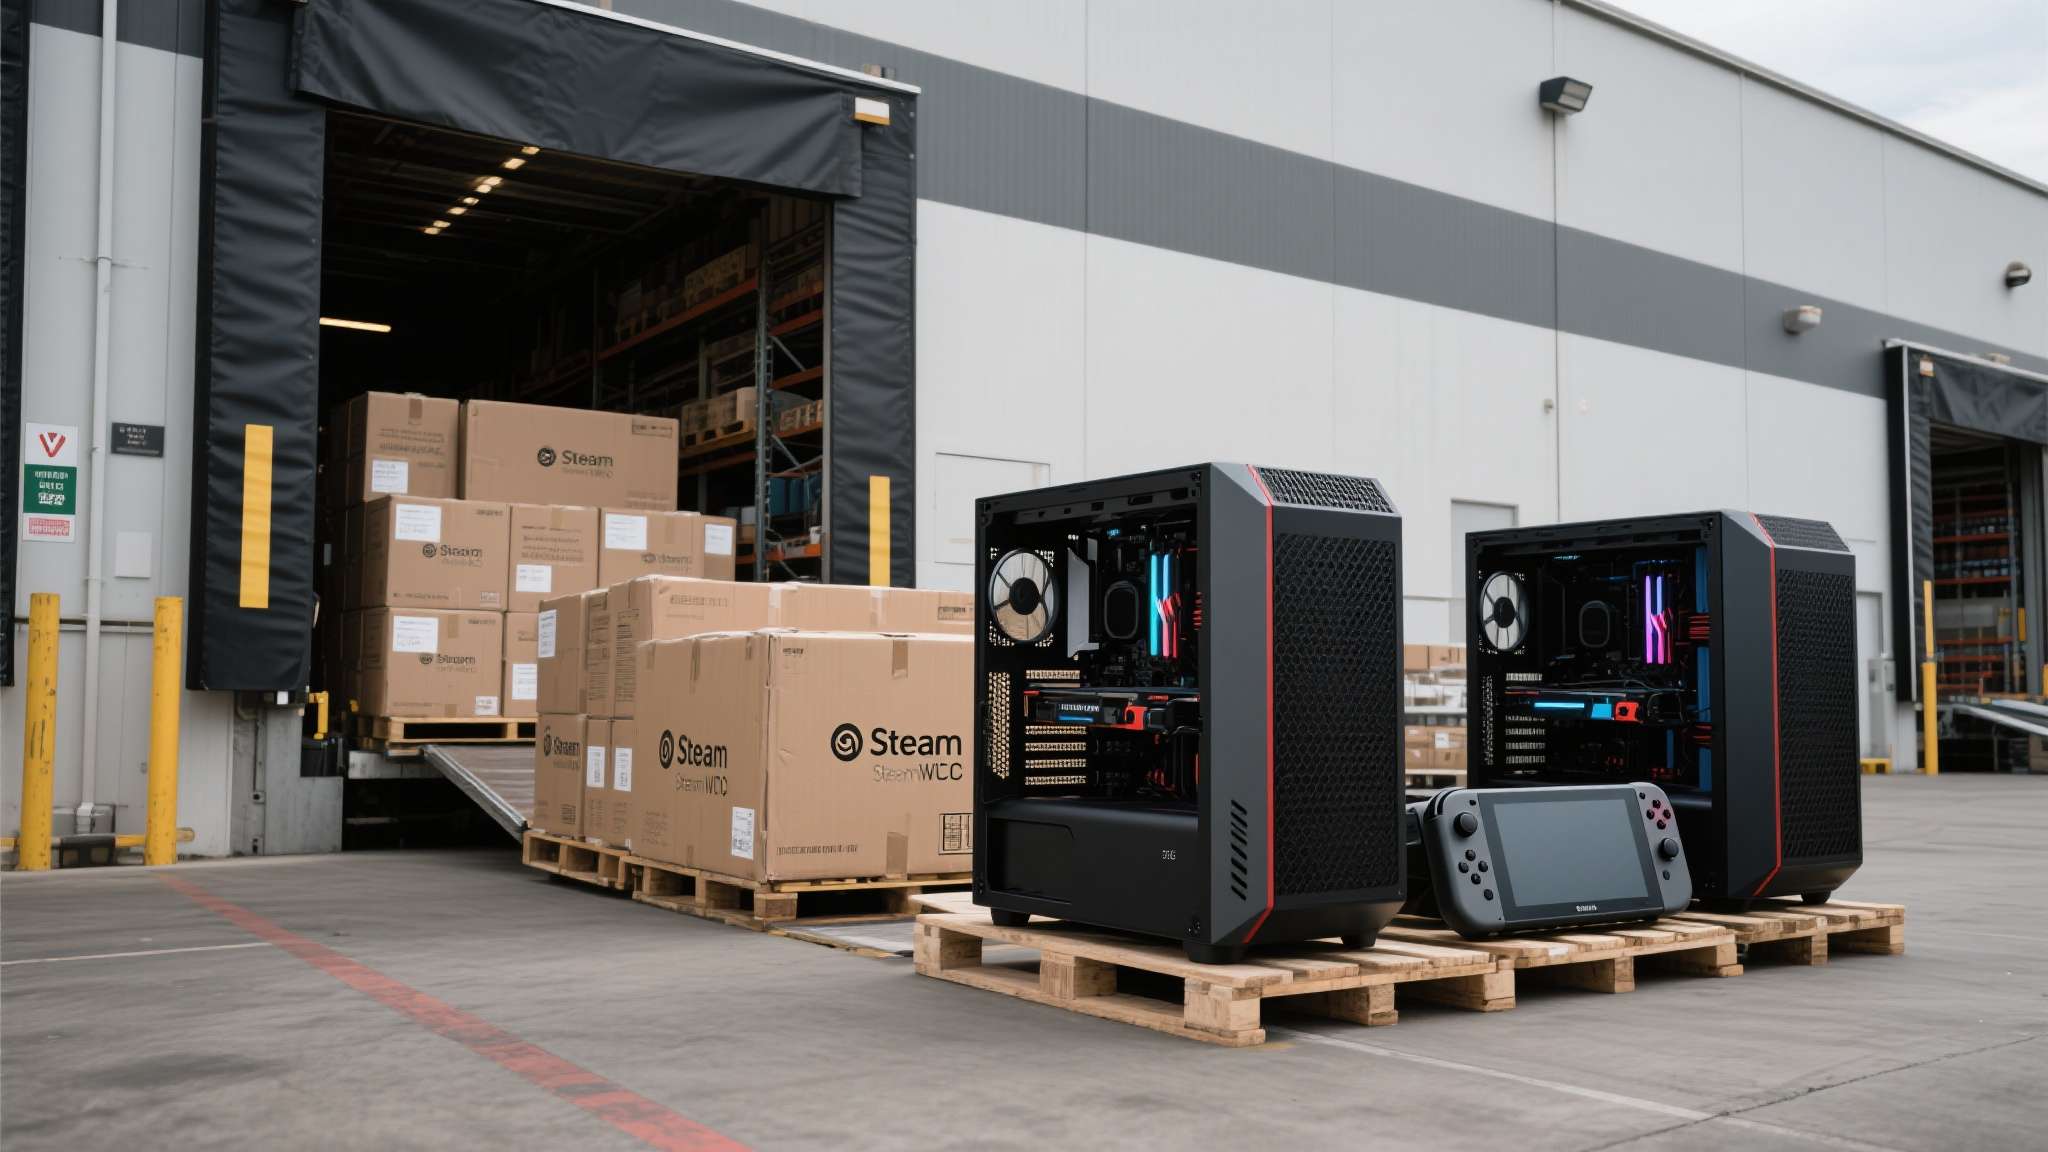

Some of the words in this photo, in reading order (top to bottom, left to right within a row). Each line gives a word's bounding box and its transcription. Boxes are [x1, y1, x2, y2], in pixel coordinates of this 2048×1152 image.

[561, 450, 614, 467] Steam
[677, 734, 728, 768] Steam
[870, 727, 962, 756] Steam
